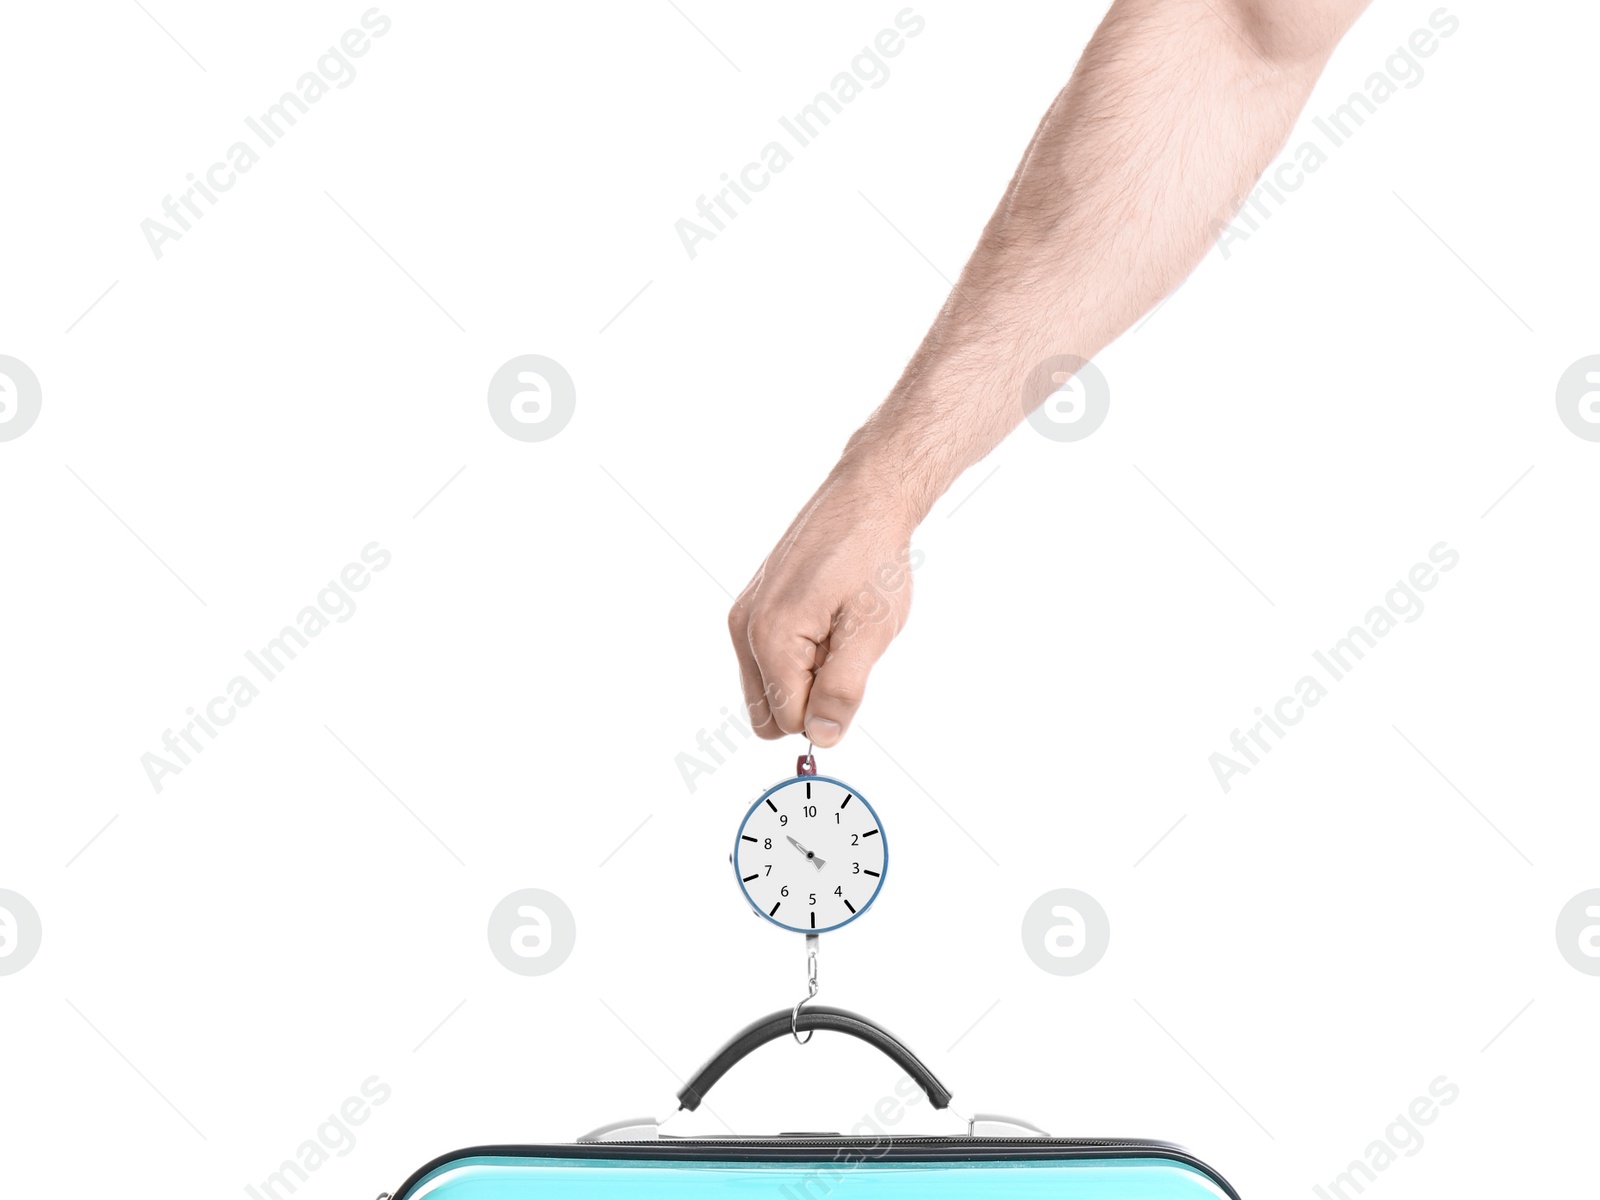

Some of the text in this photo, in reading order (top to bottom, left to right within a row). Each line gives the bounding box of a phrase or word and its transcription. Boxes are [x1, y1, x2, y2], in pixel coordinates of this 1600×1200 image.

[803, 806, 817, 818] 10
[779, 815, 788, 827] 9
[834, 812, 840, 825] 1
[764, 838, 772, 850] 8
[851, 834, 859, 846] 2
[764, 865, 772, 877] 7
[852, 863, 860, 875] 3
[780, 886, 789, 898] 6
[834, 886, 843, 898] 4
[808, 894, 816, 906] 5
